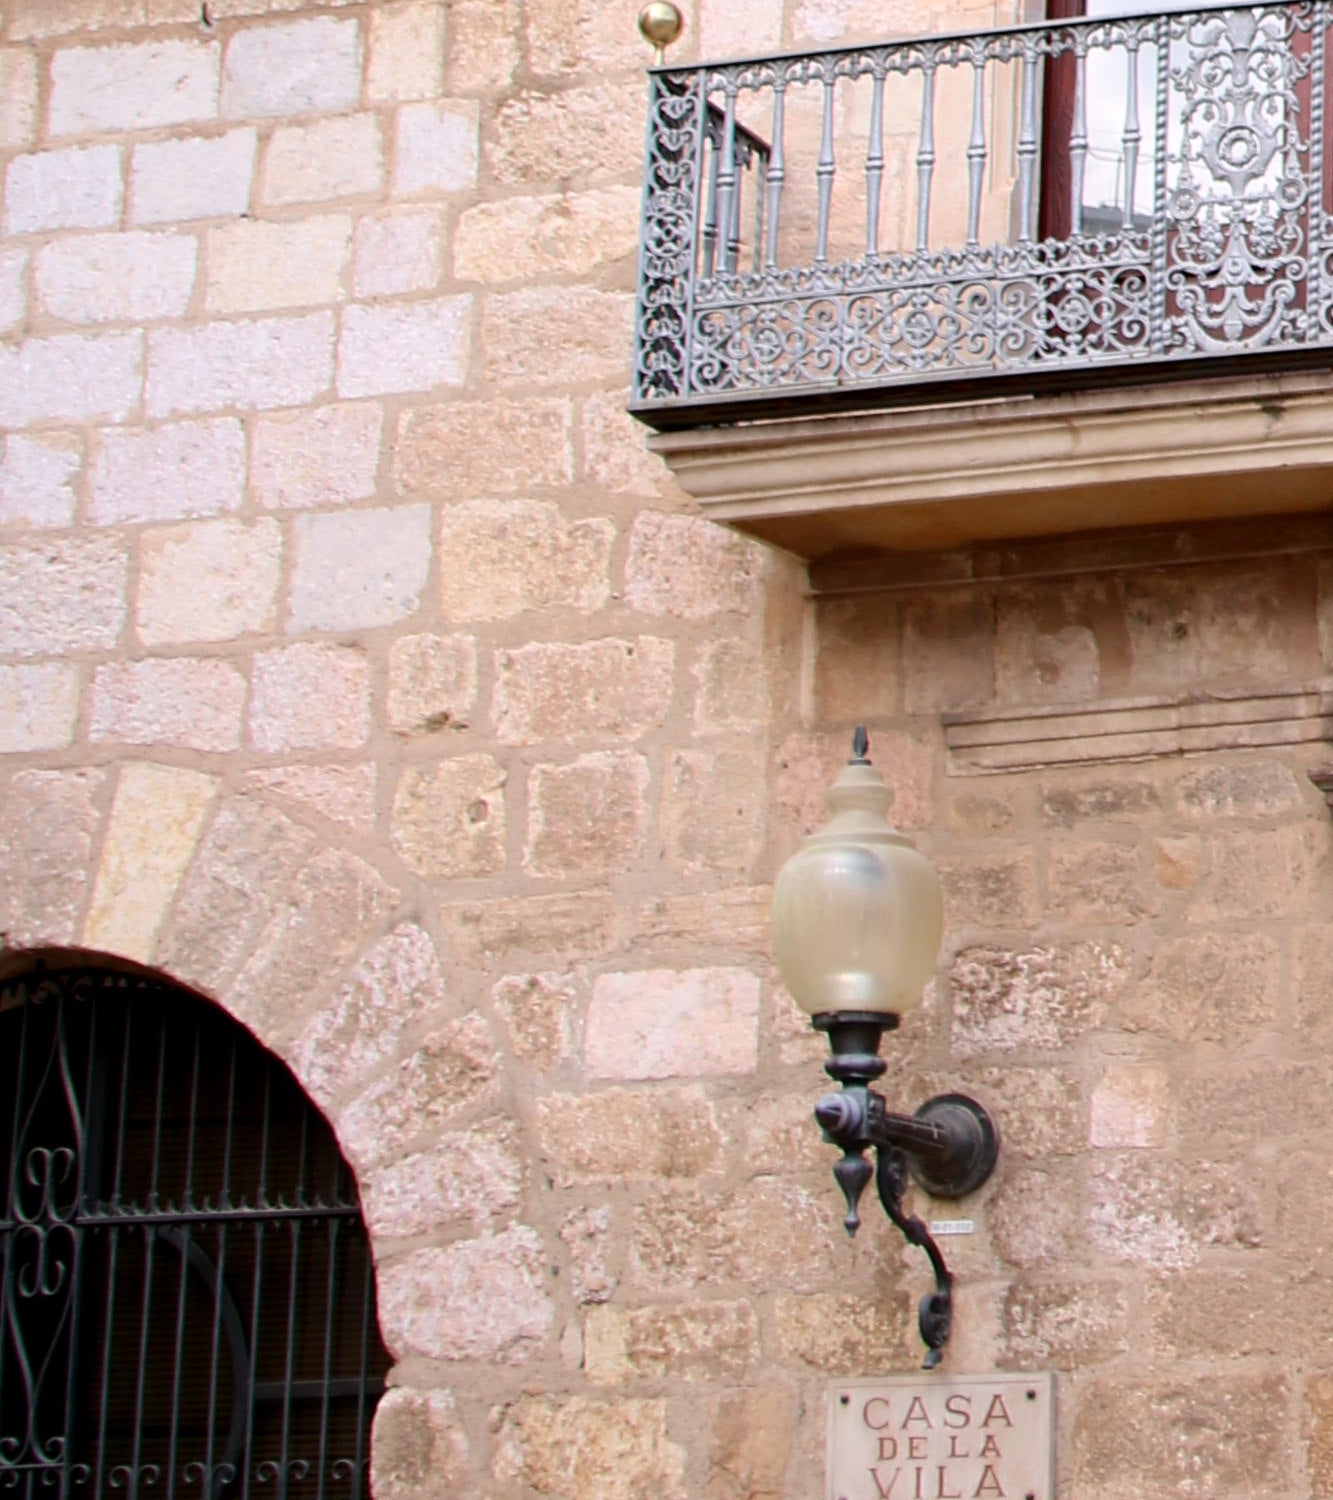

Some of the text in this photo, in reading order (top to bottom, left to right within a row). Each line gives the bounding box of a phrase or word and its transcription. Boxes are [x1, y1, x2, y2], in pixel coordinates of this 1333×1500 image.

[863, 1394, 1014, 1430] CASA
[878, 1434, 1002, 1461] DE LA
[869, 1464, 1006, 1500] VILA
